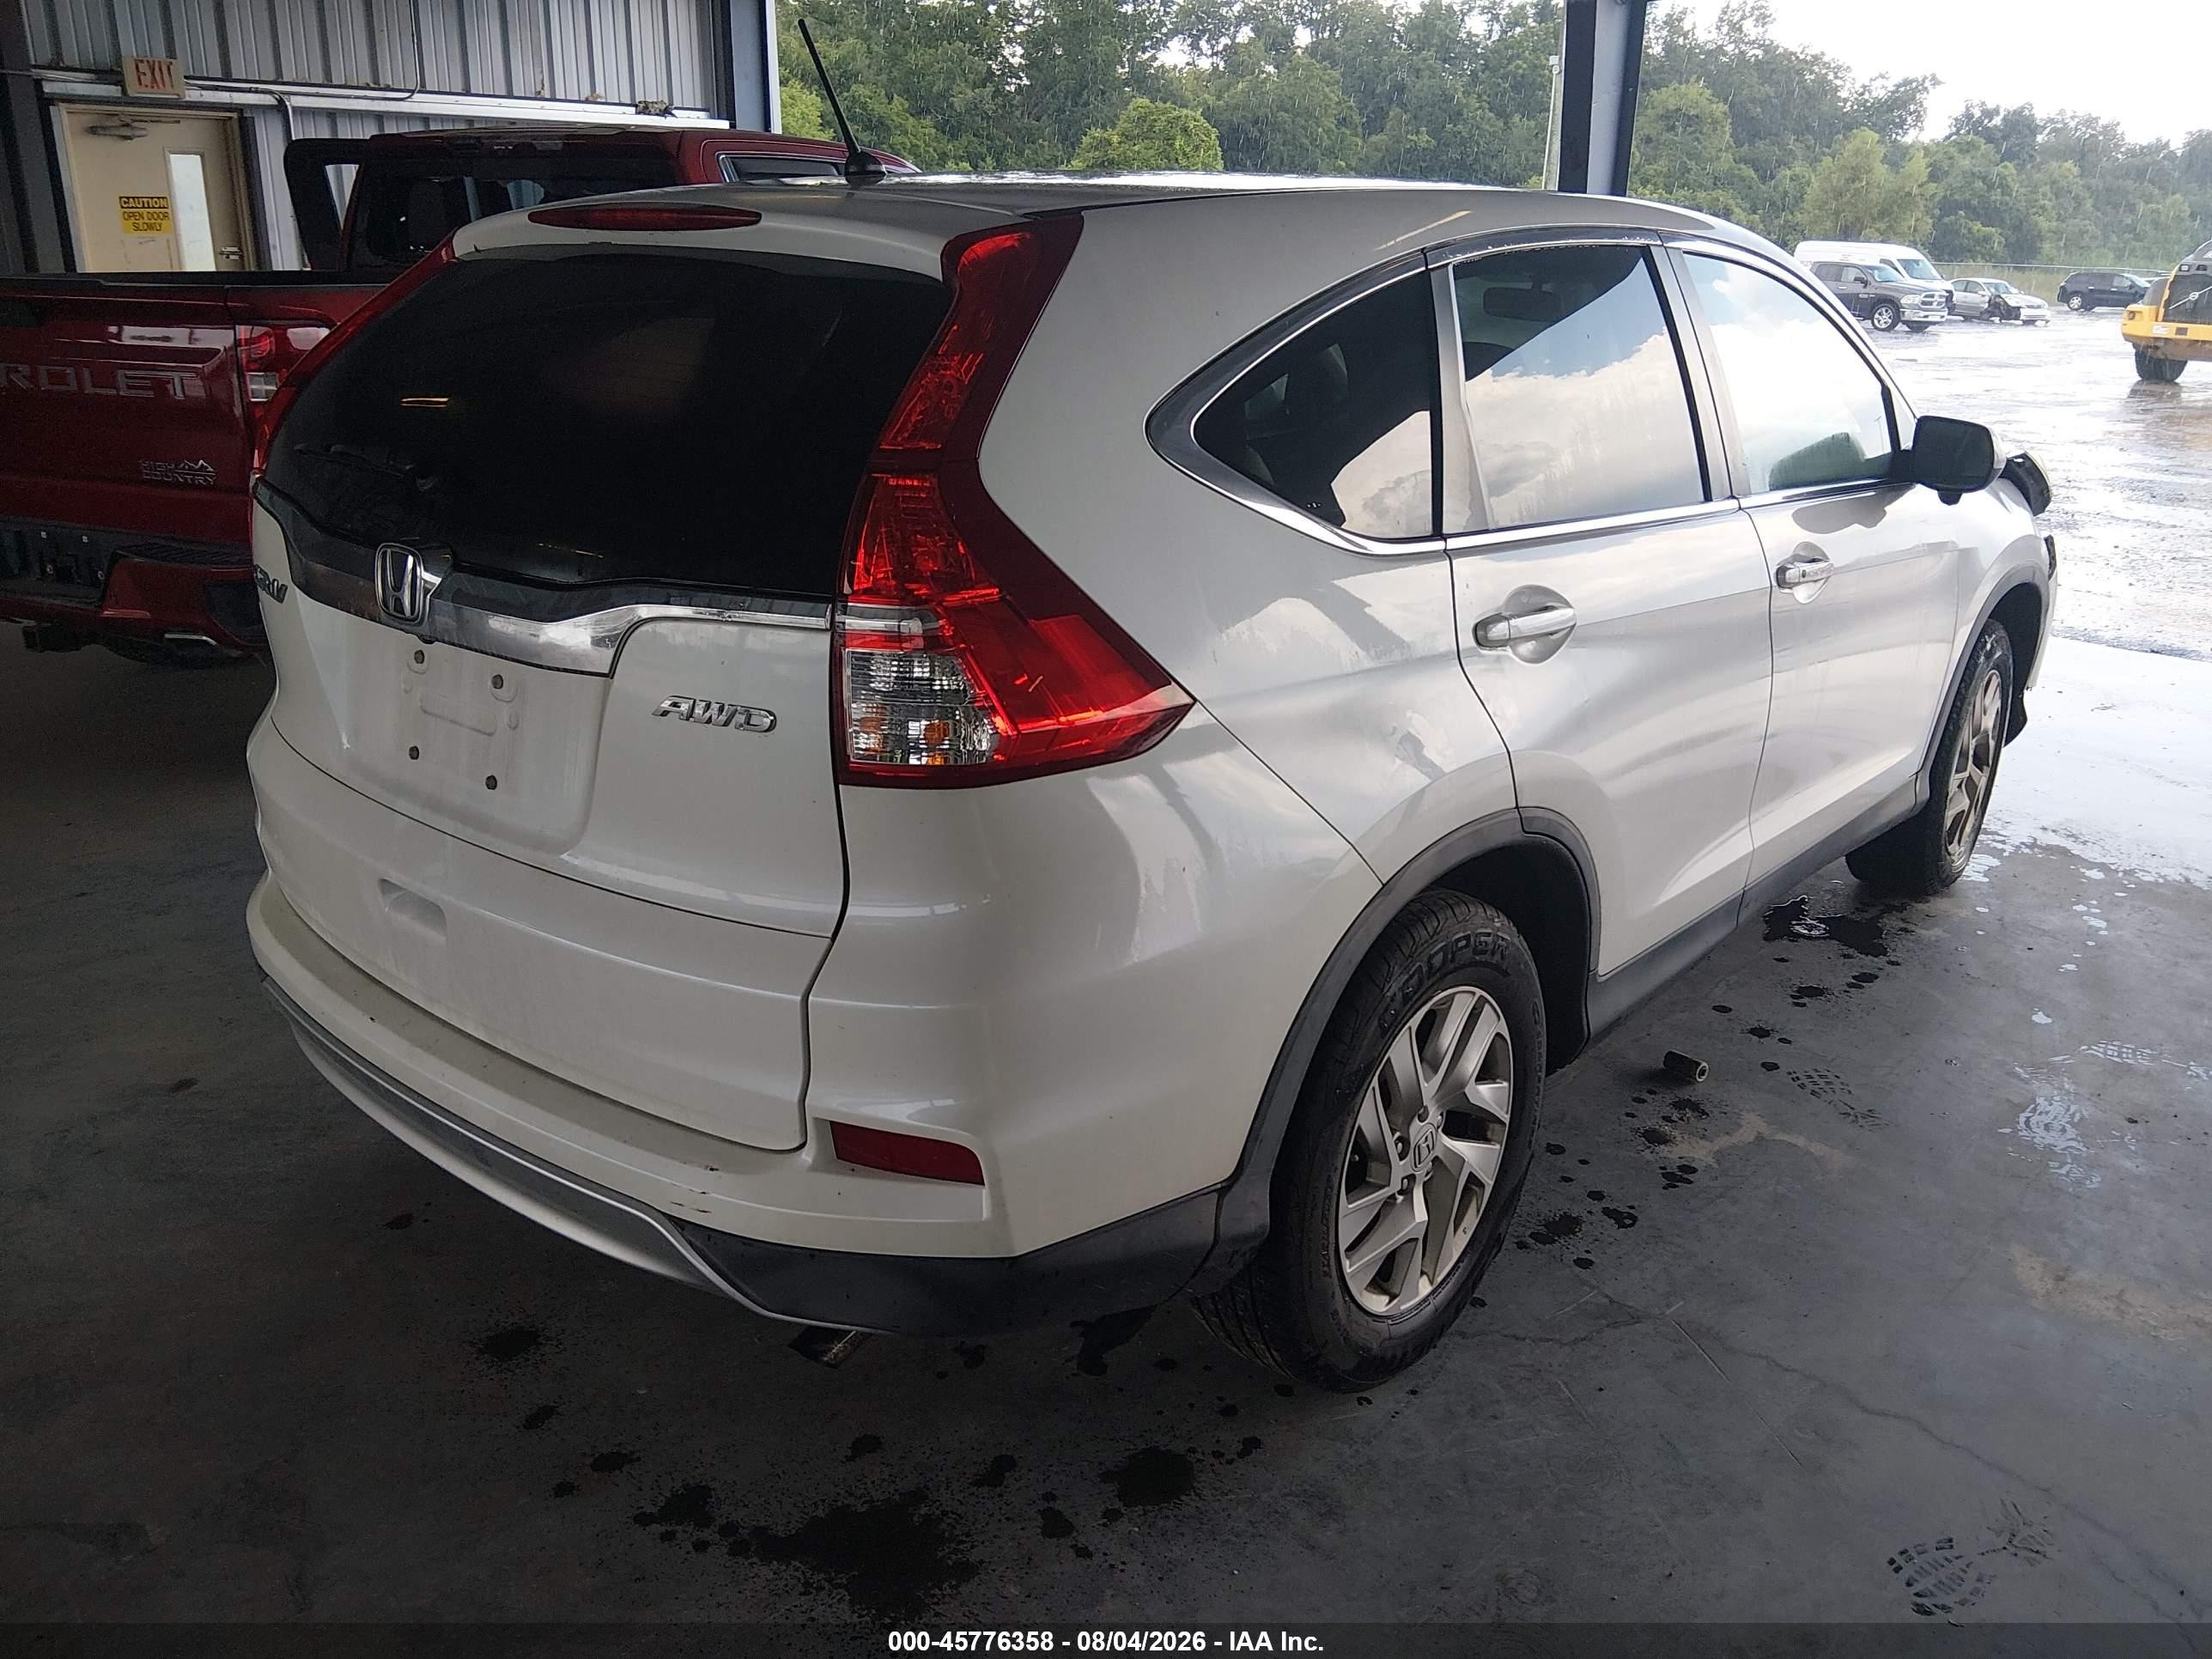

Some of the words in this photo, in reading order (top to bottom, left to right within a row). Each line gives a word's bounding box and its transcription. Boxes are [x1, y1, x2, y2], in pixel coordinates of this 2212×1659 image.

[134, 58, 174, 90] EXIT
[120, 198, 168, 208] CAUTION
[122, 211, 145, 221] OPEN
[146, 211, 170, 221] DOOR
[131, 222, 162, 232] SLOWLY
[652, 694, 777, 733] AWD
